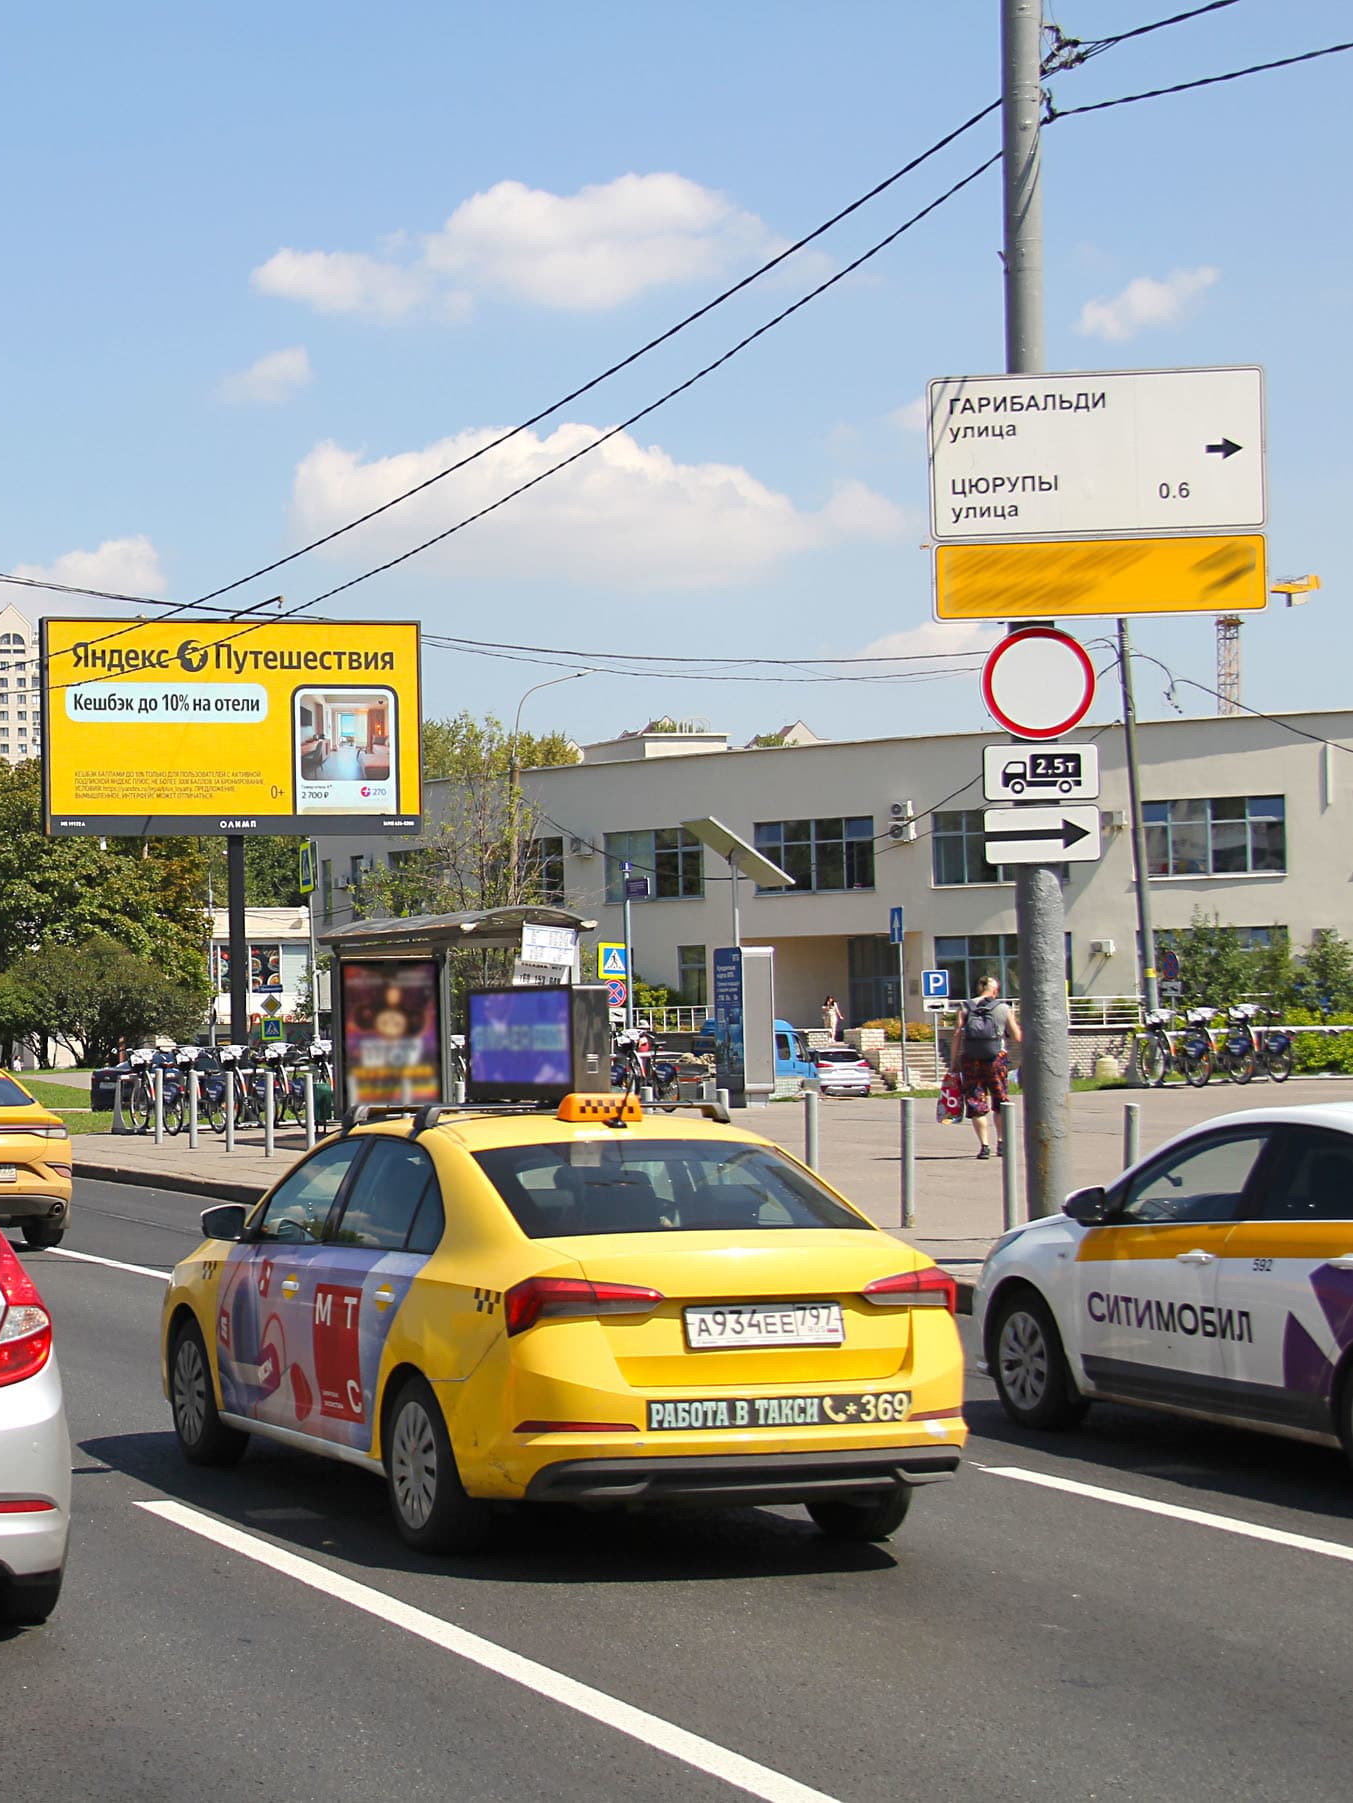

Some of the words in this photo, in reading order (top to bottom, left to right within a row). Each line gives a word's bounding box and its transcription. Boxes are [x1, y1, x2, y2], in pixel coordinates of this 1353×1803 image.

[948, 392, 1107, 416] ГАРИБАЛЬДИ
[949, 424, 1017, 443] улица
[951, 475, 1059, 498] ЦЮРУПЫ
[1159, 482, 1190, 499] 0.6
[951, 504, 1019, 524] улица
[72, 642, 169, 672] Яндекс
[215, 643, 394, 674] Путешествия
[73, 693, 134, 711] Кешбэк
[138, 698, 158, 714] до
[162, 694, 190, 711] 10%
[193, 698, 211, 711] на
[215, 698, 260, 712] отели
[1035, 759, 1076, 775] 2,5т
[271, 785, 285, 799] 0+
[372, 788, 387, 796] 270
[219, 820, 257, 828] ОЛИМП
[929, 973, 944, 994] P
[1252, 1259, 1273, 1272] 592
[796, 1306, 832, 1326] 797
[1087, 1291, 1253, 1343] СИТИМОБИЛ
[651, 1402, 729, 1429] РАБОТА
[735, 1402, 749, 1425] В
[755, 1398, 820, 1425] ТАКСИ
